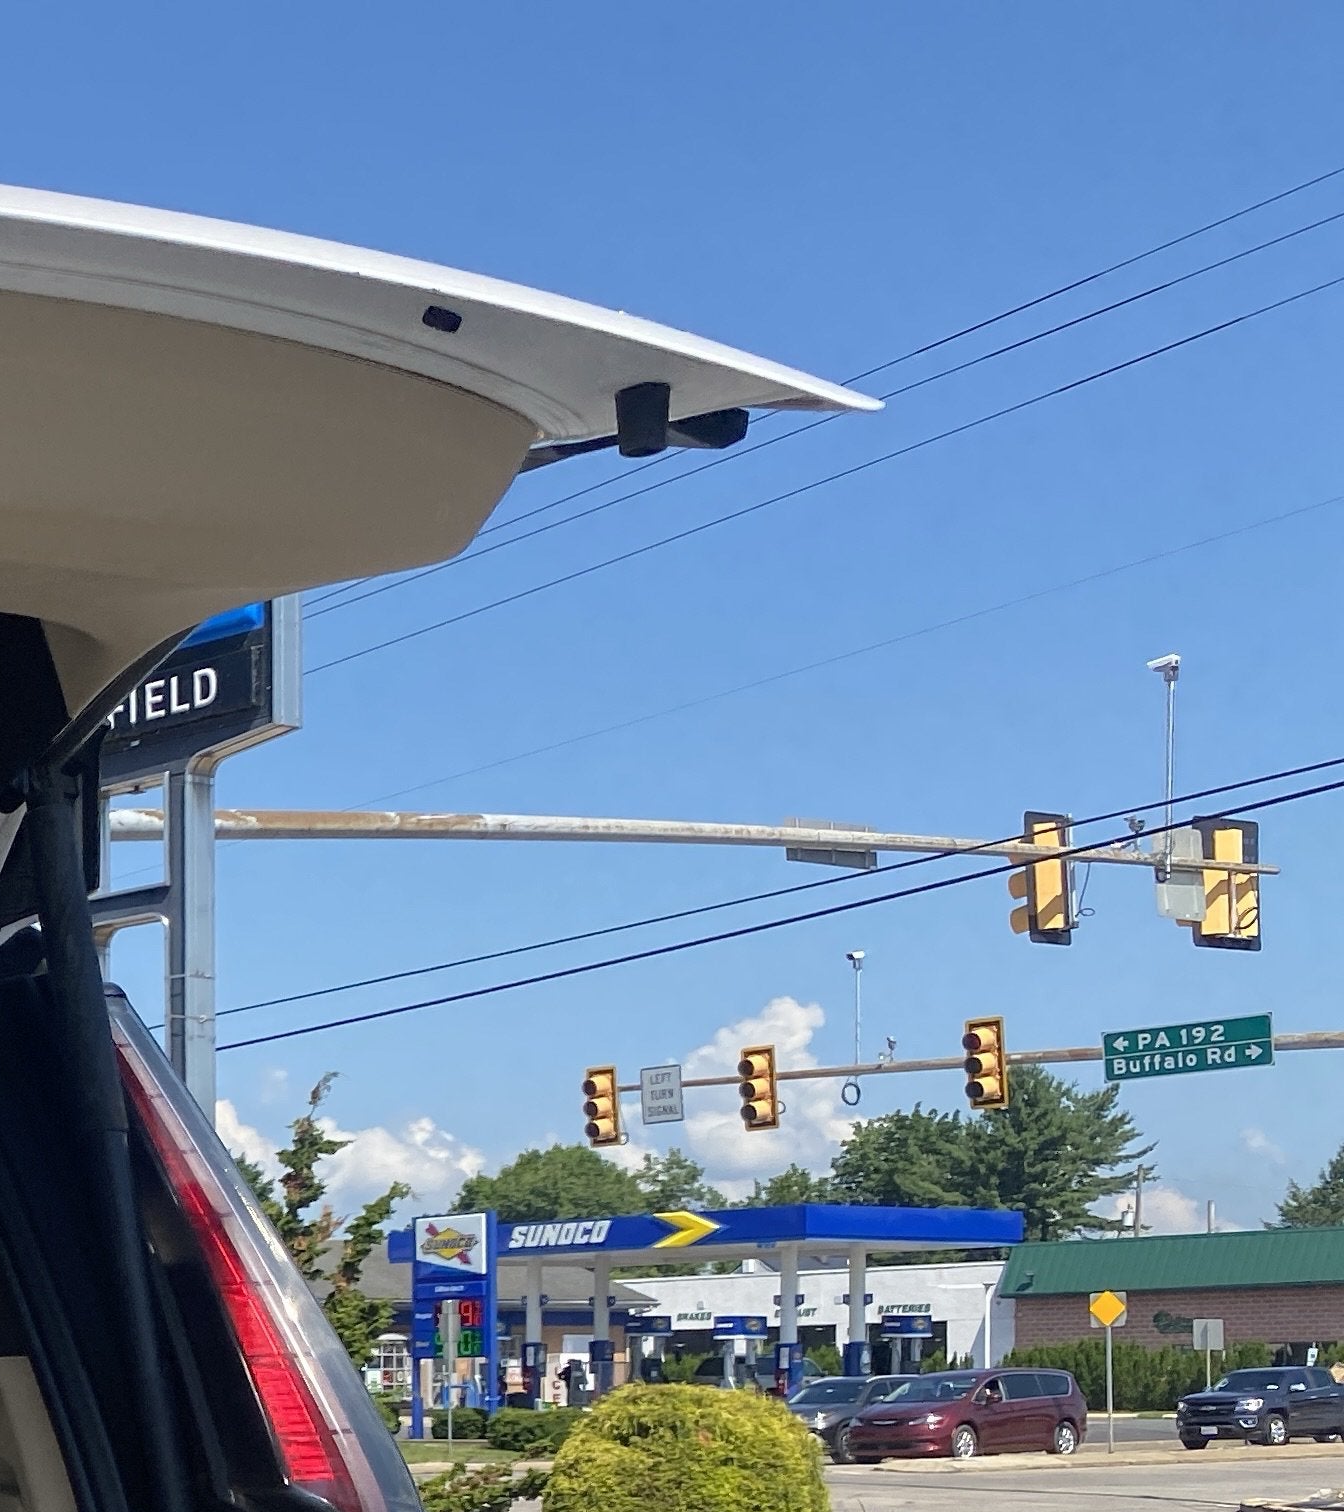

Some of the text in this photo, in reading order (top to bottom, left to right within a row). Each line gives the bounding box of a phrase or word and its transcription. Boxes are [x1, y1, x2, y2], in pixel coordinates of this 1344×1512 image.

[1137, 1024, 1226, 1050] PA 192
[1113, 1046, 1236, 1075] Buffalo Rd
[508, 1220, 611, 1249] SUNOCO
